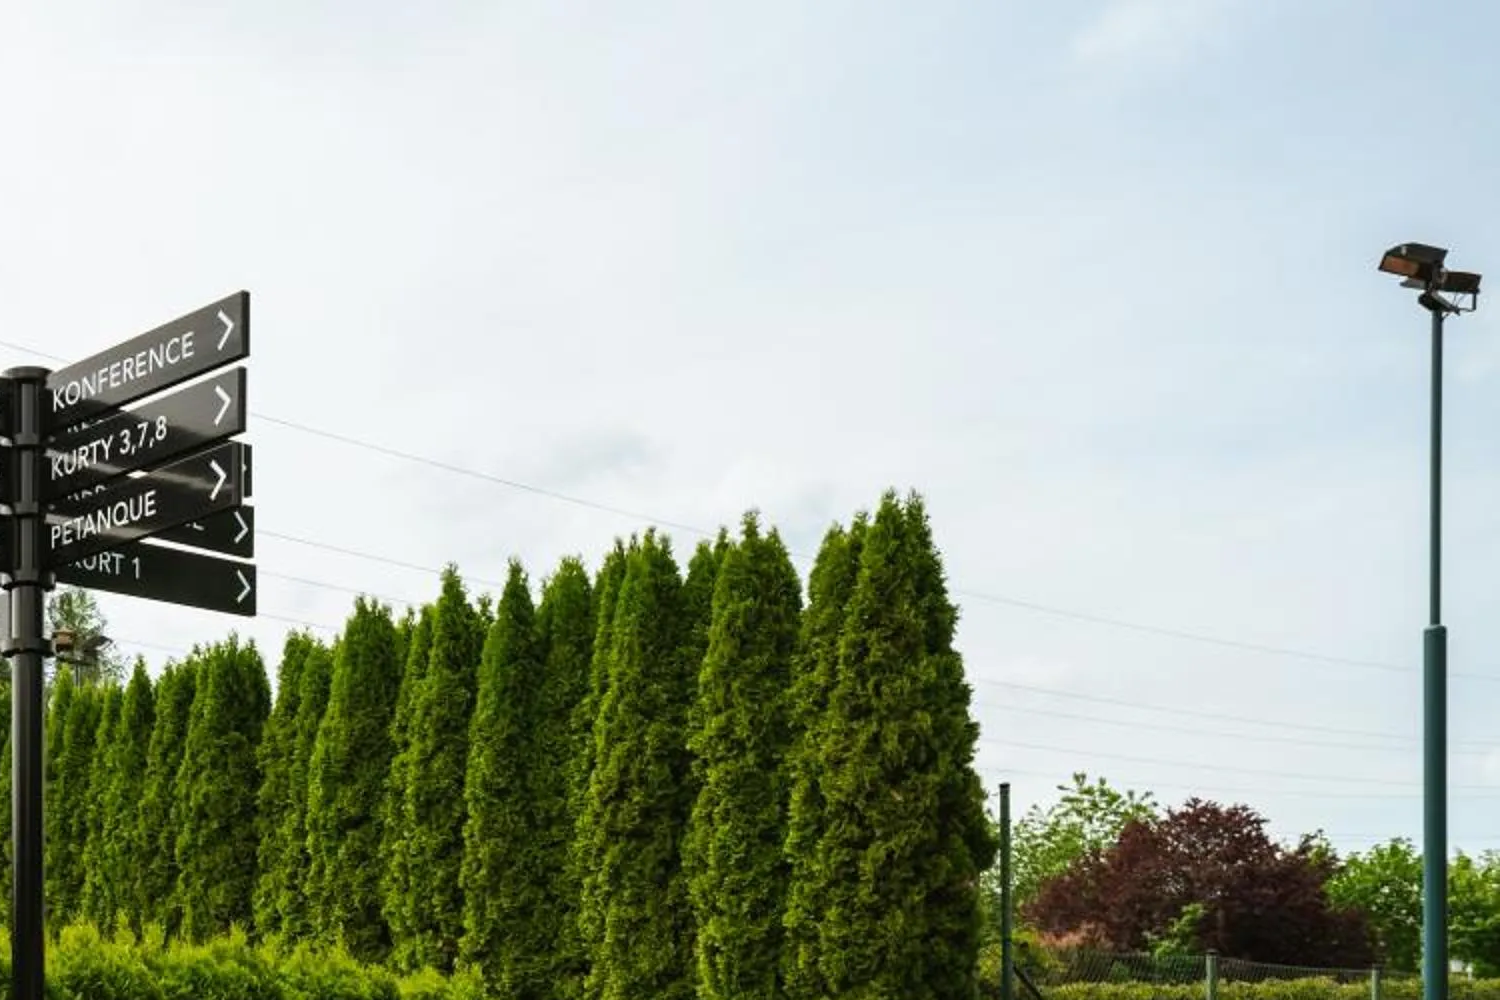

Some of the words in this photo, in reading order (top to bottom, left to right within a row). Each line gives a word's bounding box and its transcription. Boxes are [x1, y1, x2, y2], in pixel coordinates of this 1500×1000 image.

[52, 331, 195, 413] KONFERENCE
[50, 434, 114, 481] KURTY
[119, 415, 168, 456] 3,7,8
[51, 490, 157, 549] PETANQUE
[68, 551, 125, 576] URT
[131, 557, 141, 579] 1
